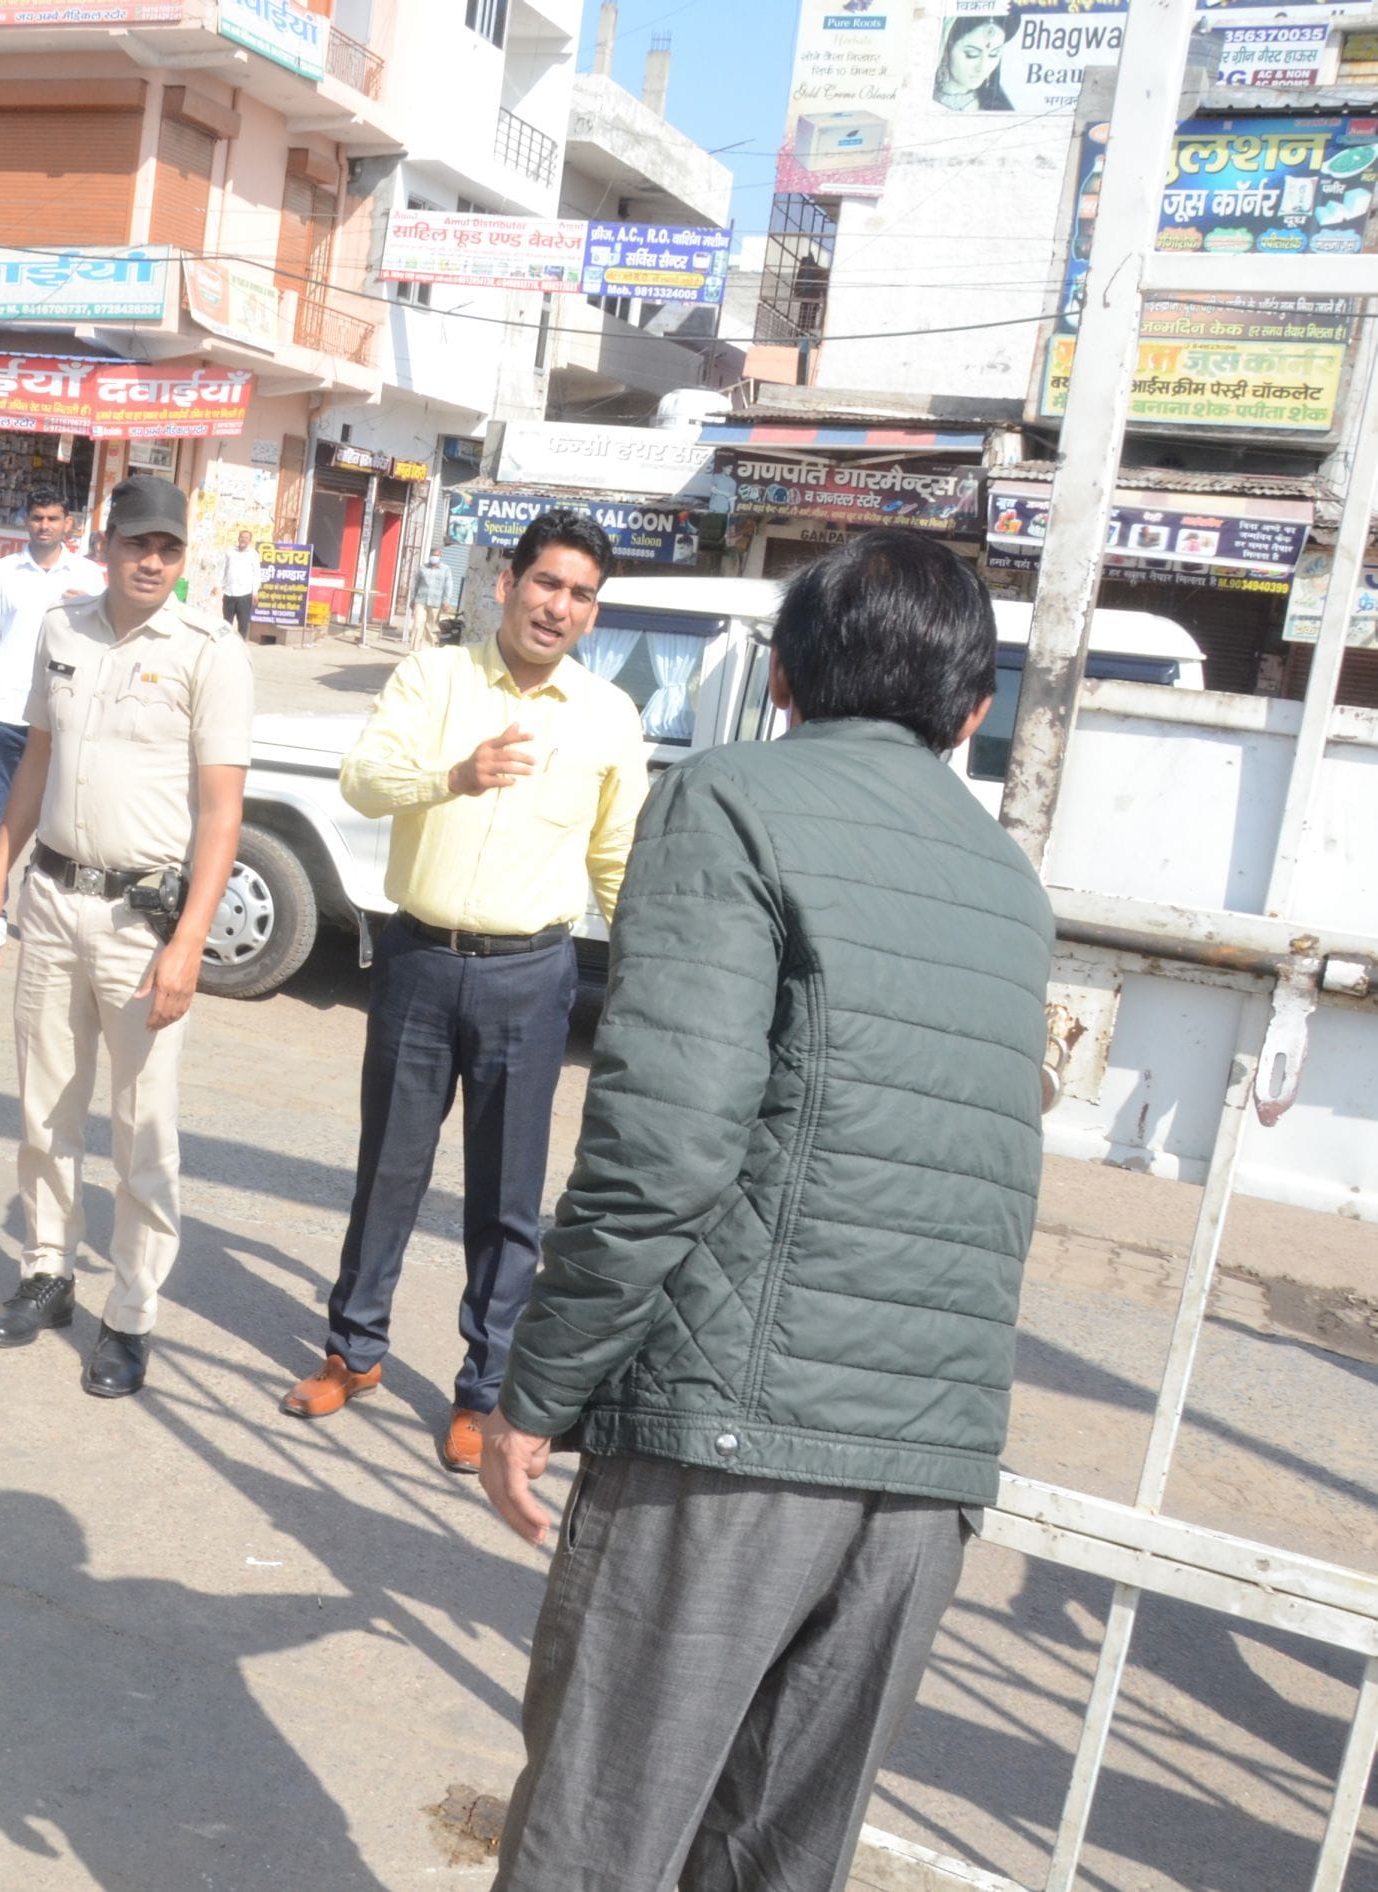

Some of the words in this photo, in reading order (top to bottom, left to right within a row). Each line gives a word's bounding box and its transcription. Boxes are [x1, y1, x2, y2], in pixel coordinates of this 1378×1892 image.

[15, 13, 33, 21] जय
[105, 8, 126, 20] स्टोर
[234, 0, 318, 45] वाईयां
[827, 18, 849, 28] Pure
[852, 17, 882, 28] Roots
[1286, 70, 1310, 78] NON
[1212, 177, 1281, 218] कॉर्नर
[392, 220, 448, 242] साहिल
[453, 230, 483, 249] फूड
[472, 219, 527, 231] Distributor
[647, 228, 670, 243] R.O.
[607, 285, 632, 297] Mob.
[1209, 320, 1245, 336] केक
[1182, 348, 1240, 378] जूस
[96, 369, 252, 408] दवाईयाँ
[1251, 379, 1324, 402] चॉकलेट
[13, 414, 36, 429] स्टोर
[1235, 401, 1286, 420] पपीता
[1287, 404, 1331, 423] शेक
[737, 459, 830, 486] गणपति
[856, 493, 883, 509] स्टोर
[477, 499, 541, 521] FANCY
[595, 508, 674, 533] SALOON
[630, 533, 663, 548] Saloon
[257, 543, 311, 566] विजय
